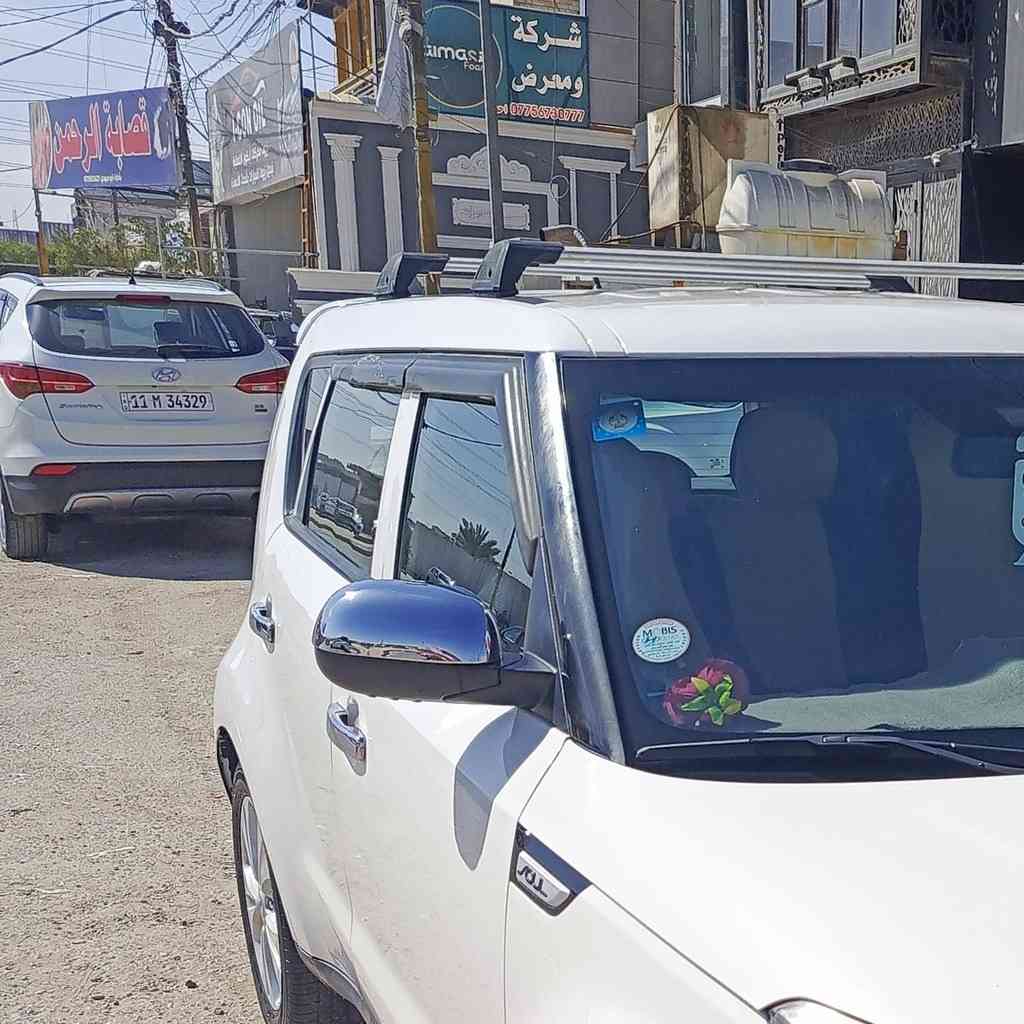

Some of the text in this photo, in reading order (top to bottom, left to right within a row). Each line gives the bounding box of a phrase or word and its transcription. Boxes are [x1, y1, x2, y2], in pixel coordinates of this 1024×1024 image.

[511, 15, 582, 51] شركة
[511, 63, 584, 98] ومعرض
[53, 96, 152, 175] قصابة الرحمن
[131, 394, 148, 409] 11
[152, 394, 162, 409] M
[165, 394, 207, 409] 34329
[642, 625, 678, 637] MBIS
